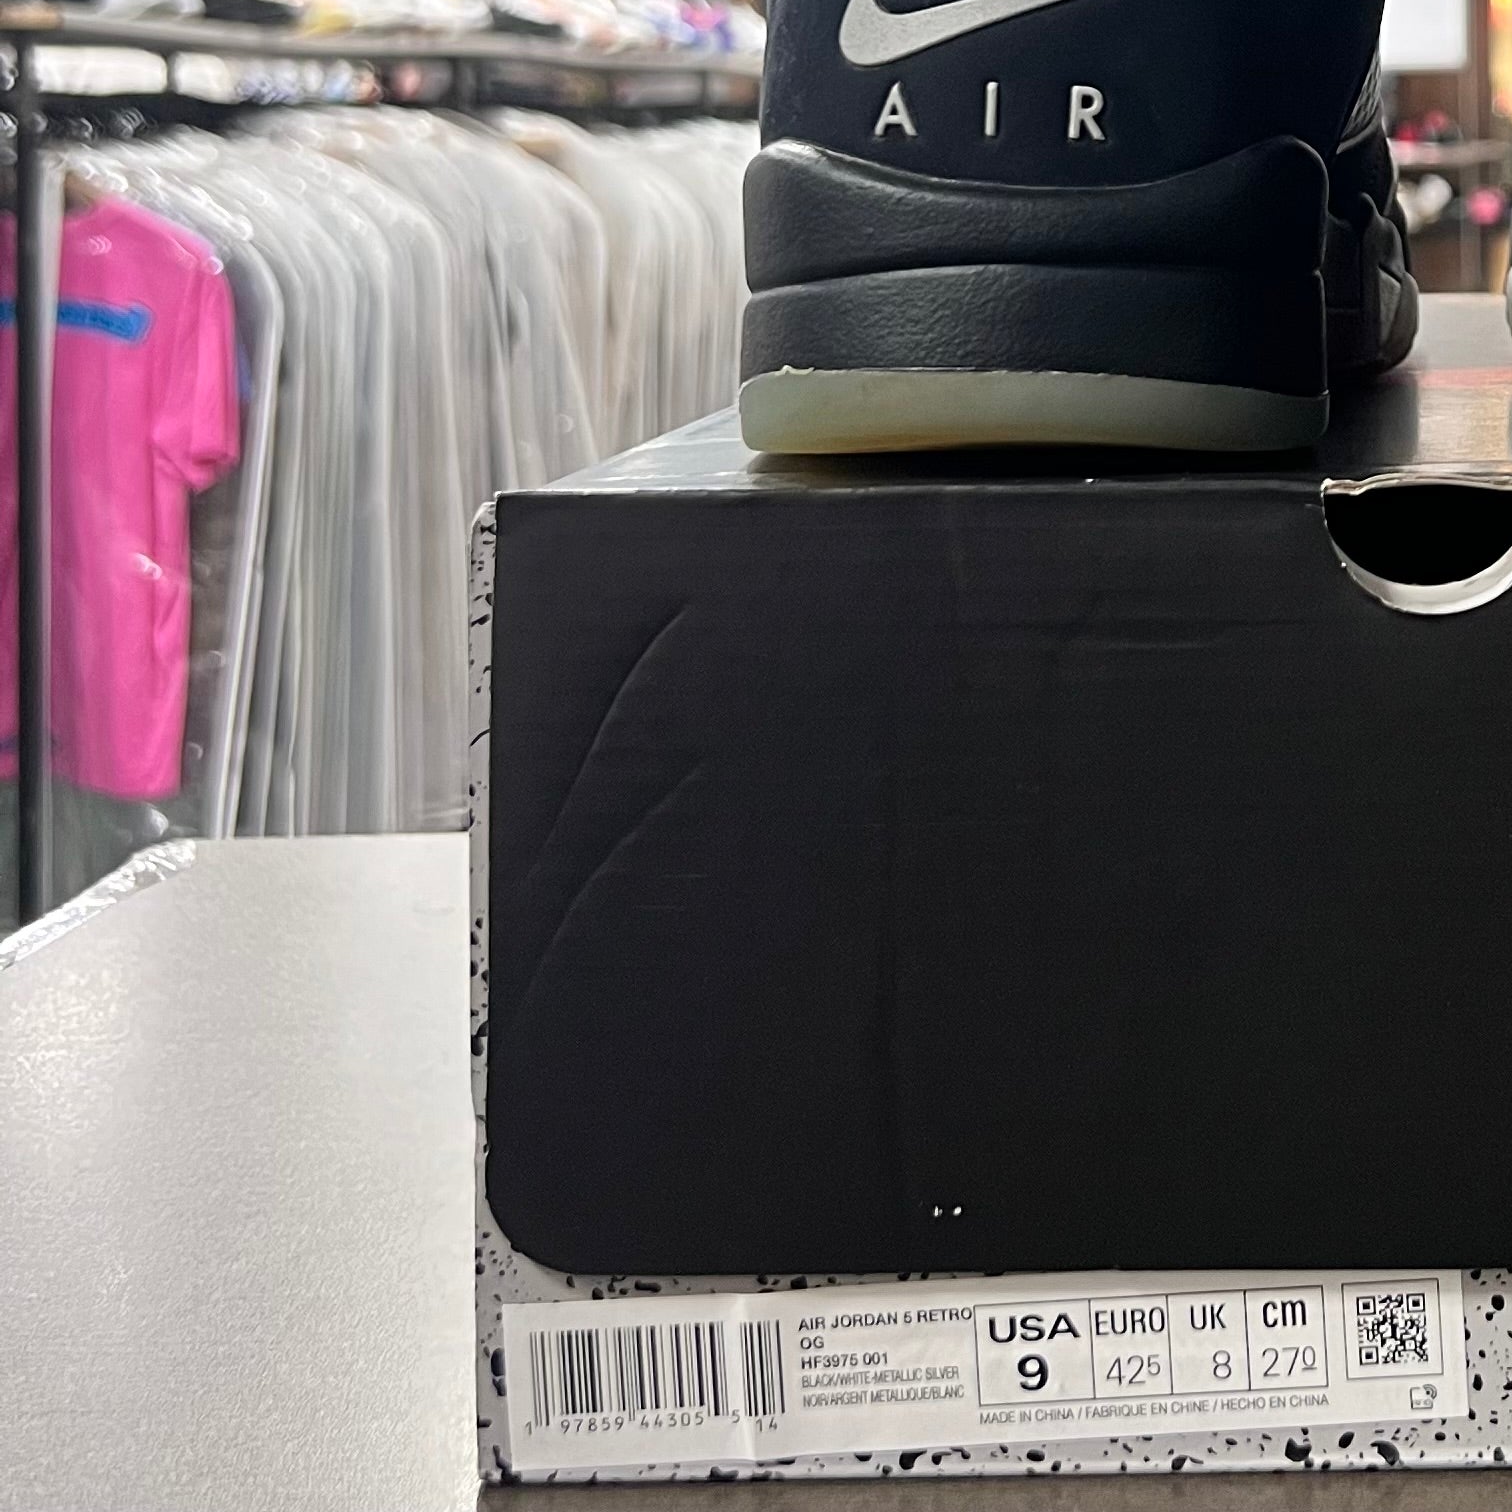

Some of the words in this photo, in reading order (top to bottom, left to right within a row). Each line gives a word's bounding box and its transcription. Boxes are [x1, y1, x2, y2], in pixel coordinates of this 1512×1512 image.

[874, 80, 1106, 141] AIR
[798, 1316, 826, 1331] AIR
[831, 1311, 898, 1328] JORDAN
[903, 1310, 912, 1324] 5
[917, 1307, 973, 1323] RETRO
[988, 1312, 1081, 1343] USA
[1094, 1306, 1166, 1336] EURO
[1190, 1303, 1227, 1330] UK
[1262, 1298, 1308, 1328] cm
[800, 1336, 825, 1350] OG
[801, 1353, 859, 1370] HF3975
[863, 1352, 888, 1366] 001
[925, 1365, 960, 1381] SILVER
[1017, 1353, 1050, 1391] 9
[1212, 1350, 1233, 1380] 8
[525, 1421, 533, 1436] 1
[560, 1416, 625, 1434] 97859
[640, 1411, 704, 1429] 44305
[732, 1410, 741, 1424] 5
[755, 1418, 778, 1432] 14
[980, 1411, 1016, 1424] MADE
[1020, 1410, 1032, 1422] IN
[1035, 1408, 1075, 1422] CHINA
[1085, 1404, 1147, 1418] FABRIQUE
[1151, 1402, 1168, 1414] EN
[1171, 1400, 1209, 1414] CHINE
[1221, 1397, 1266, 1410] HECHO
[1270, 1396, 1287, 1409] EN
[1289, 1394, 1330, 1407] CHINA
